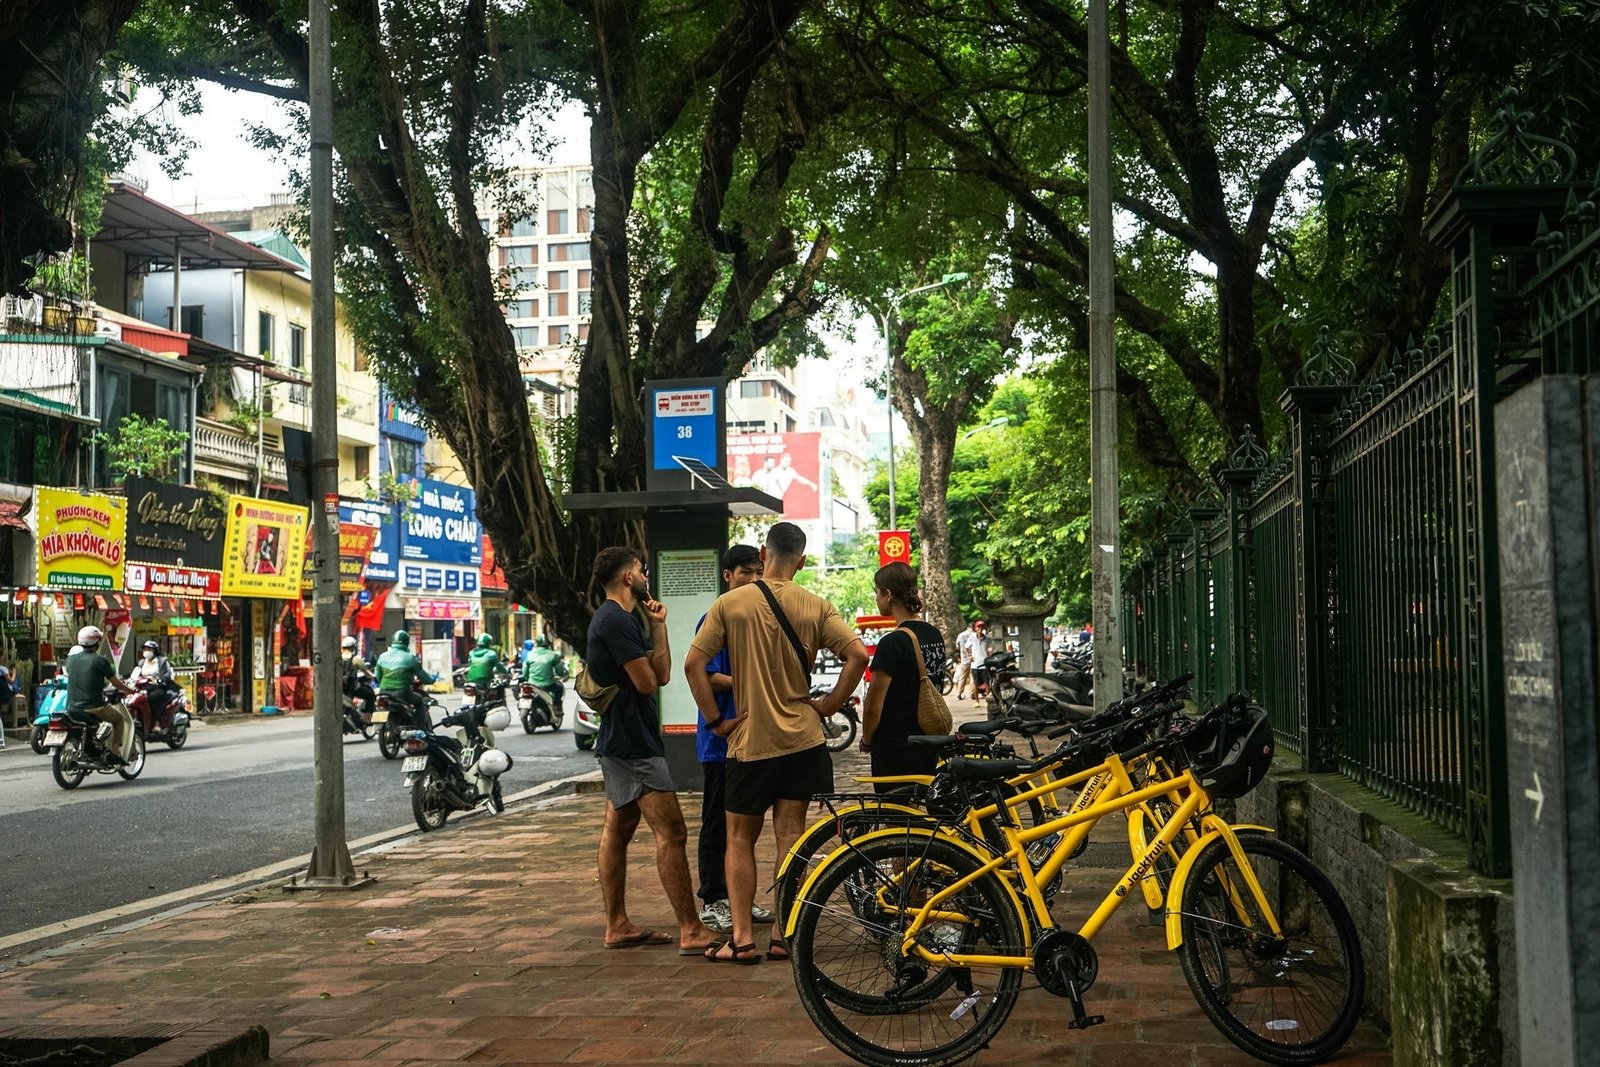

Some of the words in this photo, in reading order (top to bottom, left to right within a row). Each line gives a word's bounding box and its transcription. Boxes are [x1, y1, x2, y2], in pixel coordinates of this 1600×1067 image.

[677, 425, 693, 439] 38
[423, 488, 440, 509] NHÀ
[440, 490, 465, 513] THUỐC
[93, 509, 111, 525] KEM
[408, 513, 443, 540] LONG
[444, 514, 478, 543] CHÂU
[41, 531, 65, 558] MÍA
[150, 567, 166, 583] Van
[168, 569, 188, 585] Mieu
[190, 571, 209, 587] Mart
[1077, 774, 1102, 811] Jackfruit
[1127, 839, 1166, 886] Jackfruit
